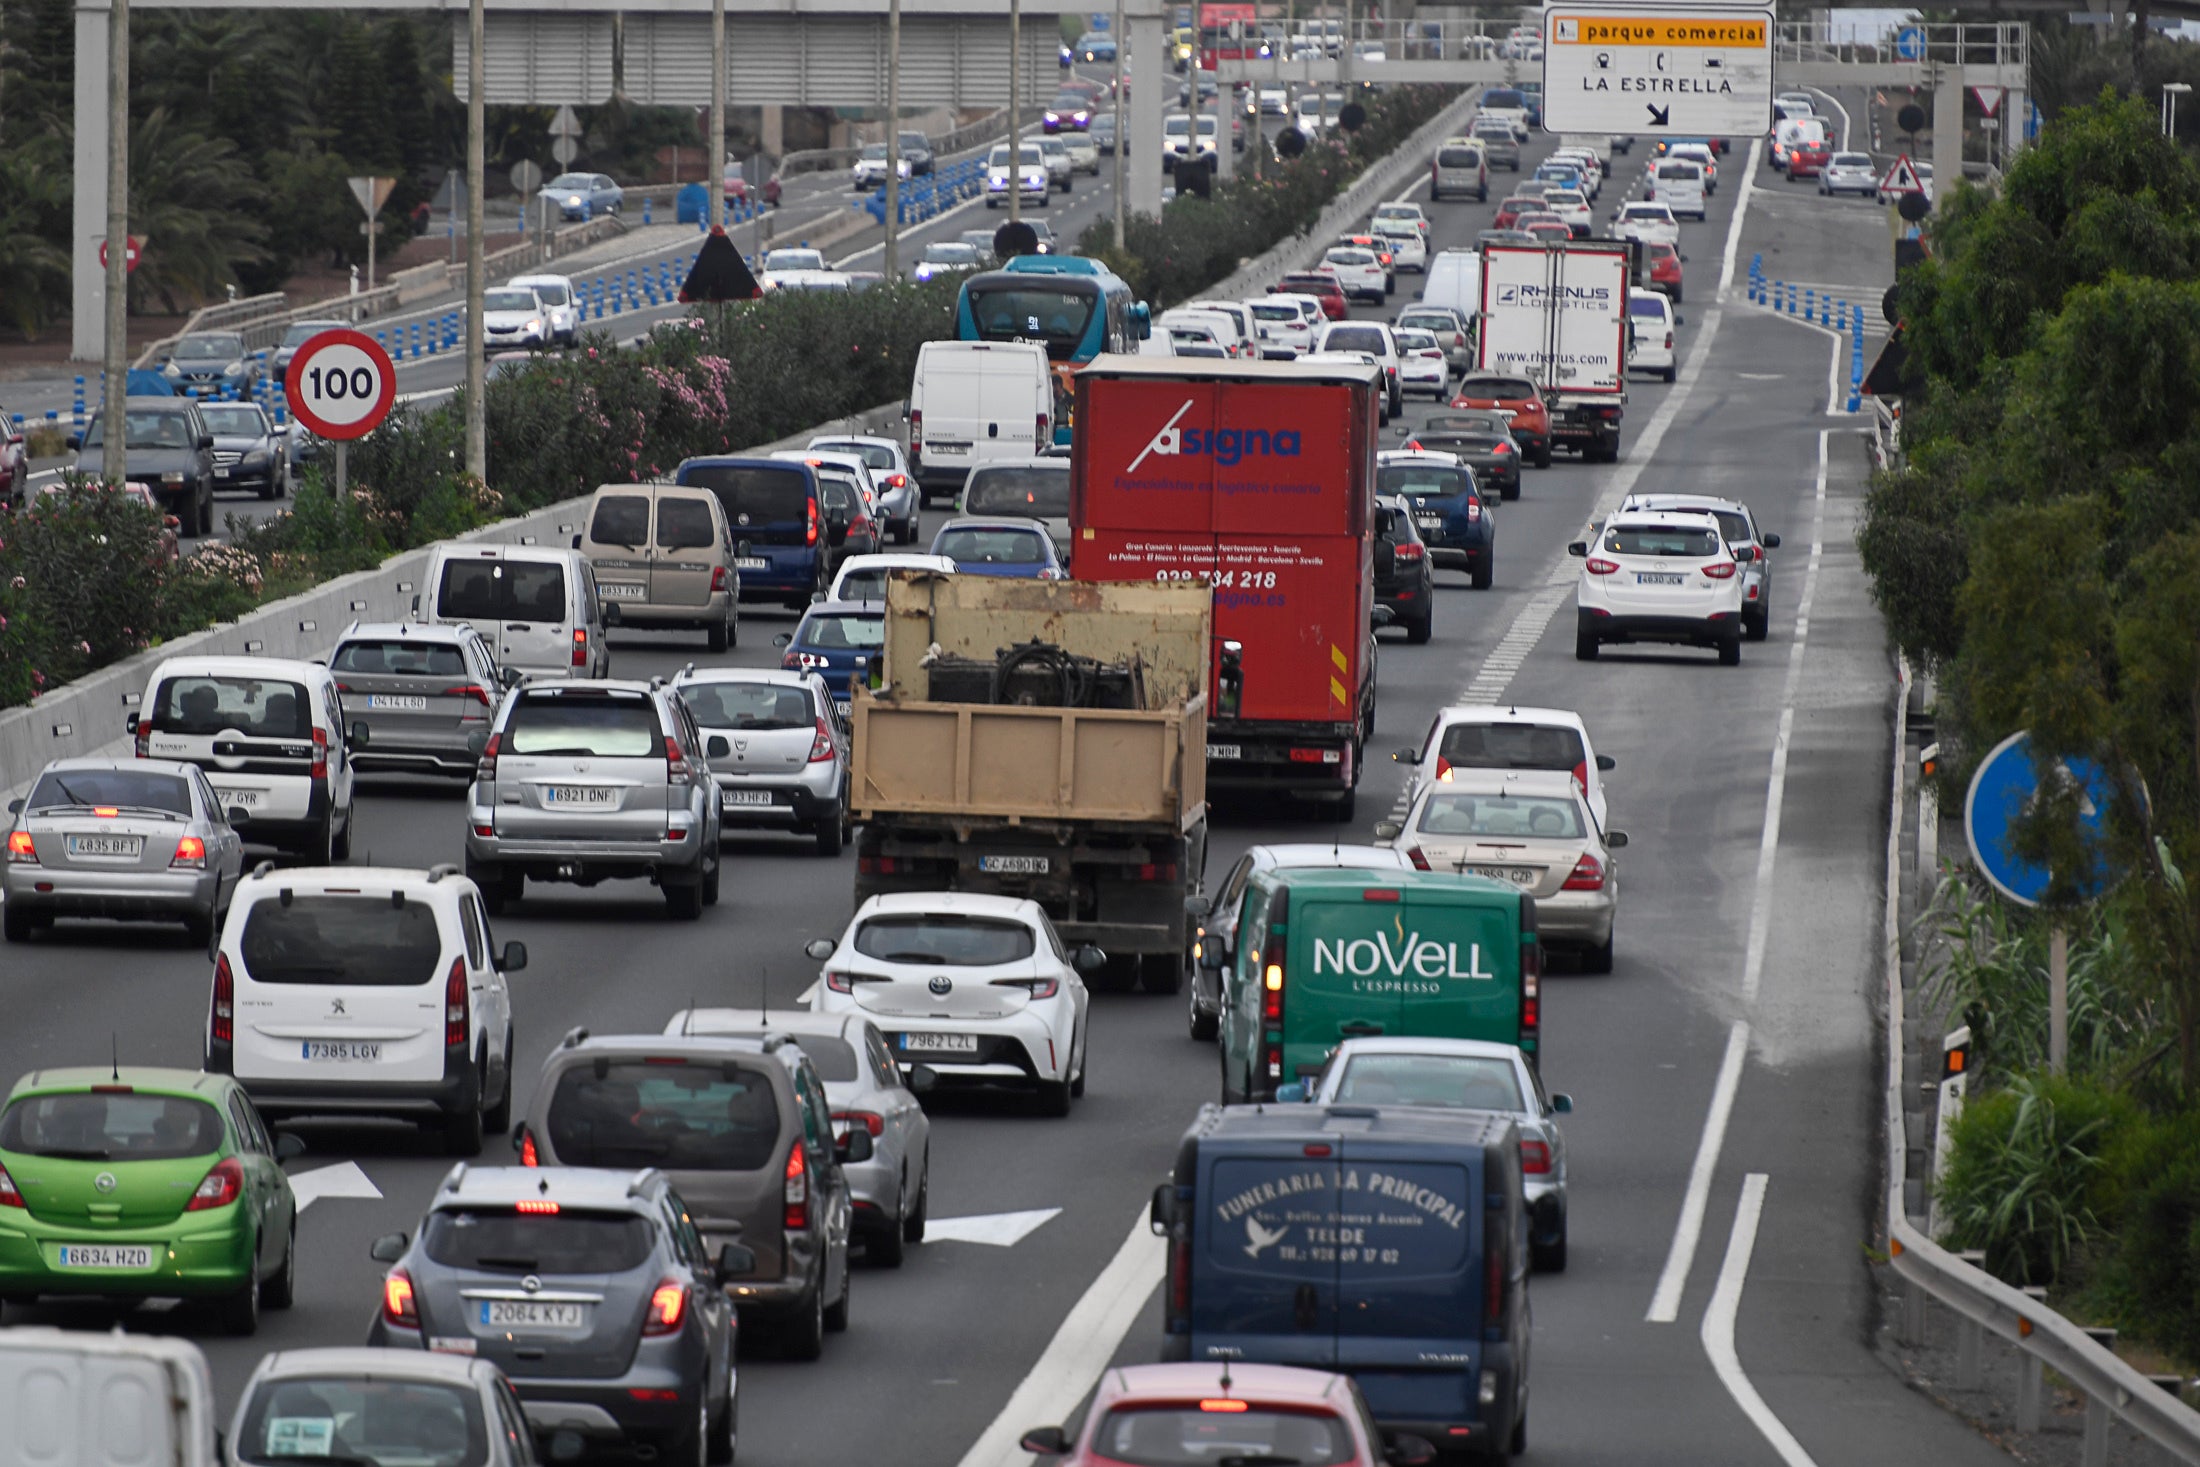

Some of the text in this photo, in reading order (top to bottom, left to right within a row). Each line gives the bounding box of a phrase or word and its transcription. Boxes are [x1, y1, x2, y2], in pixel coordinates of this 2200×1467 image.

[1587, 24, 1764, 42] parque comercial
[1583, 77, 1733, 94] LA ESTRELLA
[1521, 285, 1609, 300] RHENUS
[309, 366, 373, 400] 100
[1125, 542, 1302, 554] Gran Canaria Lanzarote Fuerteventura Tenerife
[1119, 552, 1141, 561] Palma
[1226, 554, 1252, 564] Madrid
[1257, 555, 1294, 565] Barcelona
[1299, 556, 1324, 566] Sevilla
[1240, 570, 1277, 589] 218
[236, 792, 257, 805] GYR
[556, 787, 584, 802] 6921
[723, 790, 745, 803] 693
[78, 837, 109, 852] 4835
[1353, 980, 1441, 993] L'ESPRESSO
[909, 1032, 944, 1048] 7962
[311, 1043, 379, 1059] 7385 LGV
[1950, 1084, 1960, 1098] 5
[1216, 1168, 1466, 1230] FUNERARIA LA PRINCIPAL
[1306, 1228, 1366, 1245] TELDE
[69, 1248, 147, 1266] 6634 HZD
[543, 1304, 578, 1323] KYJ
